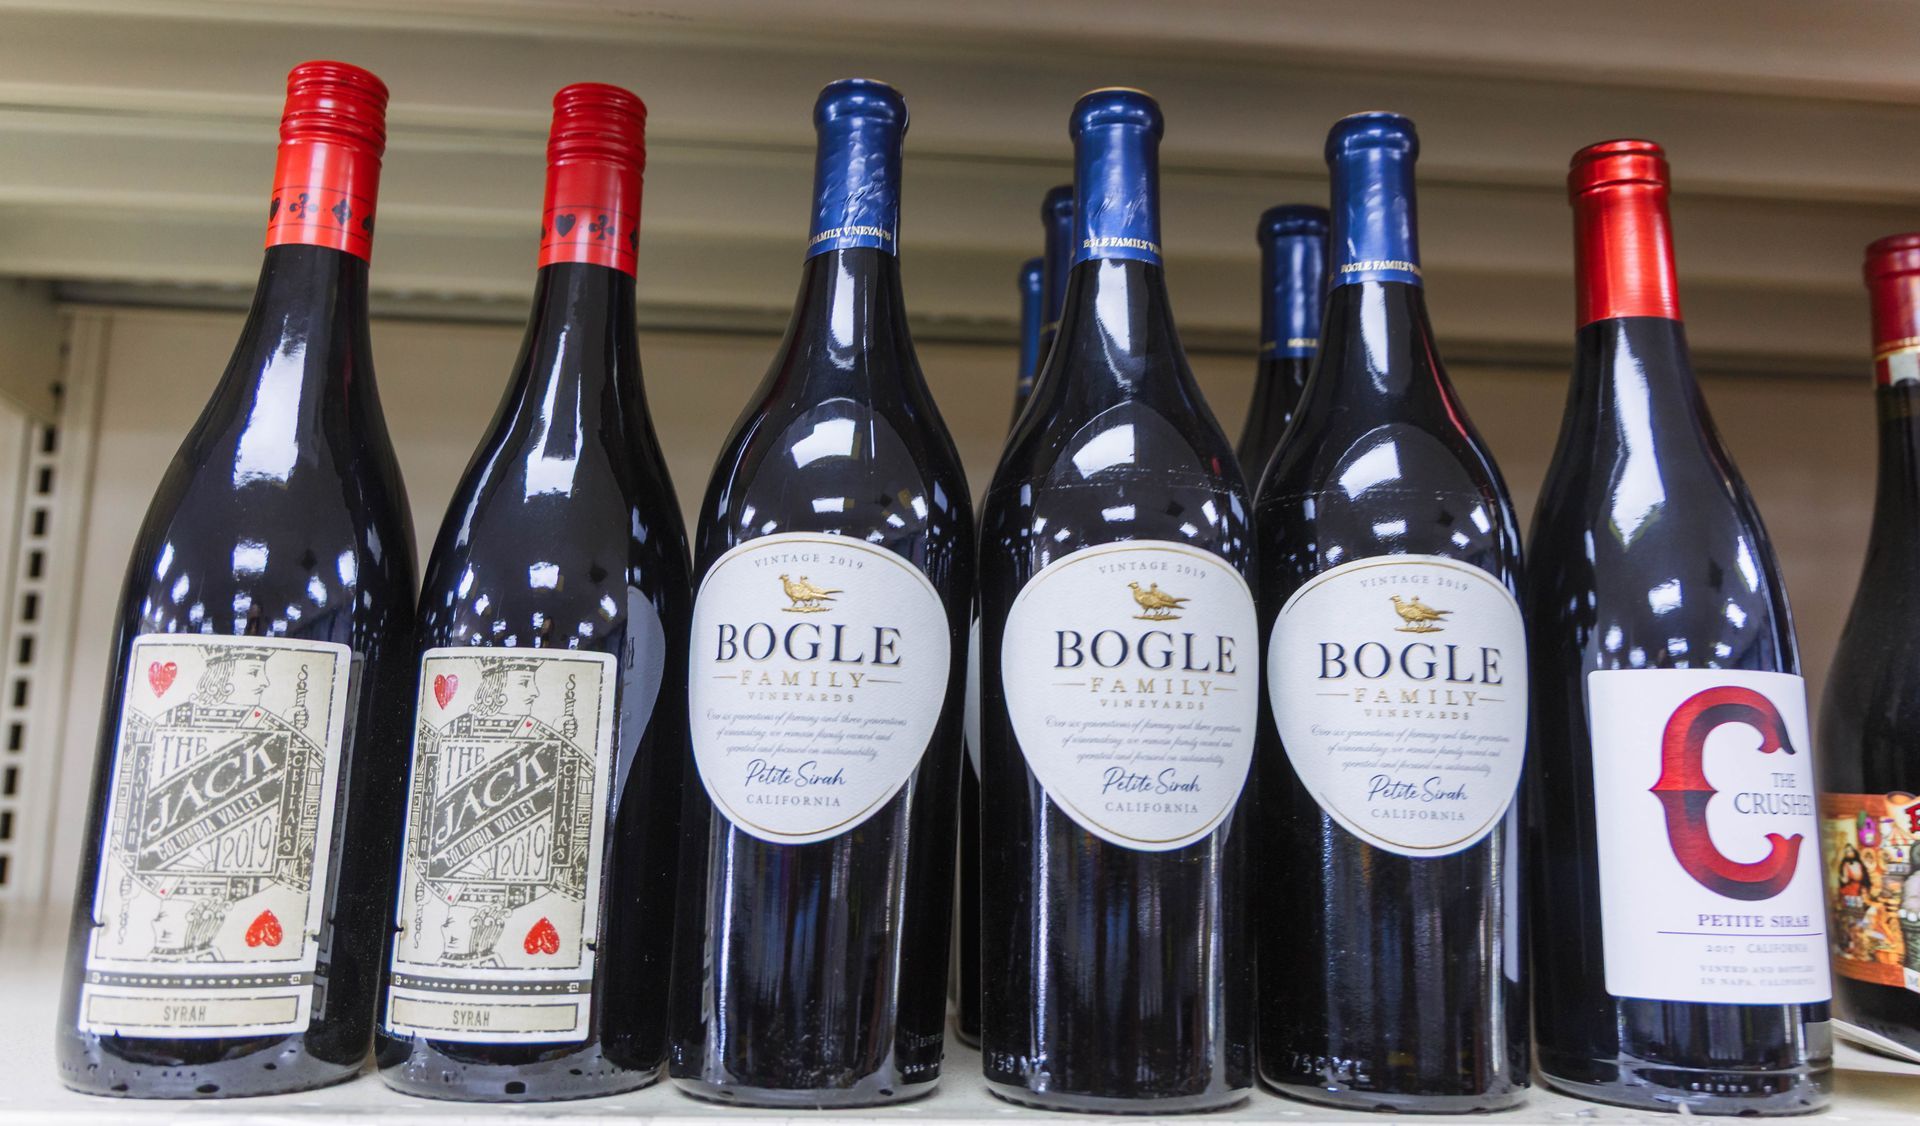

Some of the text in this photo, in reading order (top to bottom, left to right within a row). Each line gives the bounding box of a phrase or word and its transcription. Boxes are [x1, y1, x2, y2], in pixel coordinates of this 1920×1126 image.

[1110, 237, 1148, 250] FAMILY
[1373, 260, 1408, 272] FAMILY
[755, 553, 864, 570] VINTAGE 2019
[1098, 561, 1207, 579] VINTAGE 2019
[1360, 575, 1469, 592] VINTAGE 2019
[715, 622, 902, 666] BOGLE
[1054, 629, 1238, 675] BOGLE
[1318, 641, 1504, 686] BOGLE
[740, 669, 866, 688] FAMILY
[1090, 677, 1213, 696] FAMILY
[748, 691, 855, 703] VINEYARDS
[1099, 698, 1206, 711] VINEYARDS
[1354, 687, 1479, 707] FAMILY
[1364, 708, 1471, 720] VINEYARDS
[160, 736, 208, 779] THE
[446, 745, 485, 788] THE
[745, 758, 848, 788] Petite Sirah
[1102, 766, 1202, 795] Petite Sirah
[1771, 772, 1796, 788] THE
[147, 732, 278, 838] JACK
[435, 743, 549, 847] JACK
[1368, 774, 1468, 803] Petite Sirah
[128, 755, 146, 845] SAVIAH
[280, 755, 303, 852] CELLARS
[421, 766, 434, 852] SAVIAH
[746, 793, 842, 808] CALIFORNIA
[1105, 801, 1199, 814] CALIFORNIA
[556, 764, 573, 860] CELLARS
[1371, 808, 1466, 821] CALIFORNIA
[157, 789, 265, 861] COLUMBIA VALLEY
[445, 799, 537, 868] COLUMBIA VALLEY
[222, 815, 273, 869] 2019
[500, 823, 546, 876] 2019
[1698, 914, 1764, 928] PETITE
[1704, 944, 1736, 954] 2017
[163, 1005, 206, 1023] SYRAH
[453, 1009, 490, 1027] SYRAH
